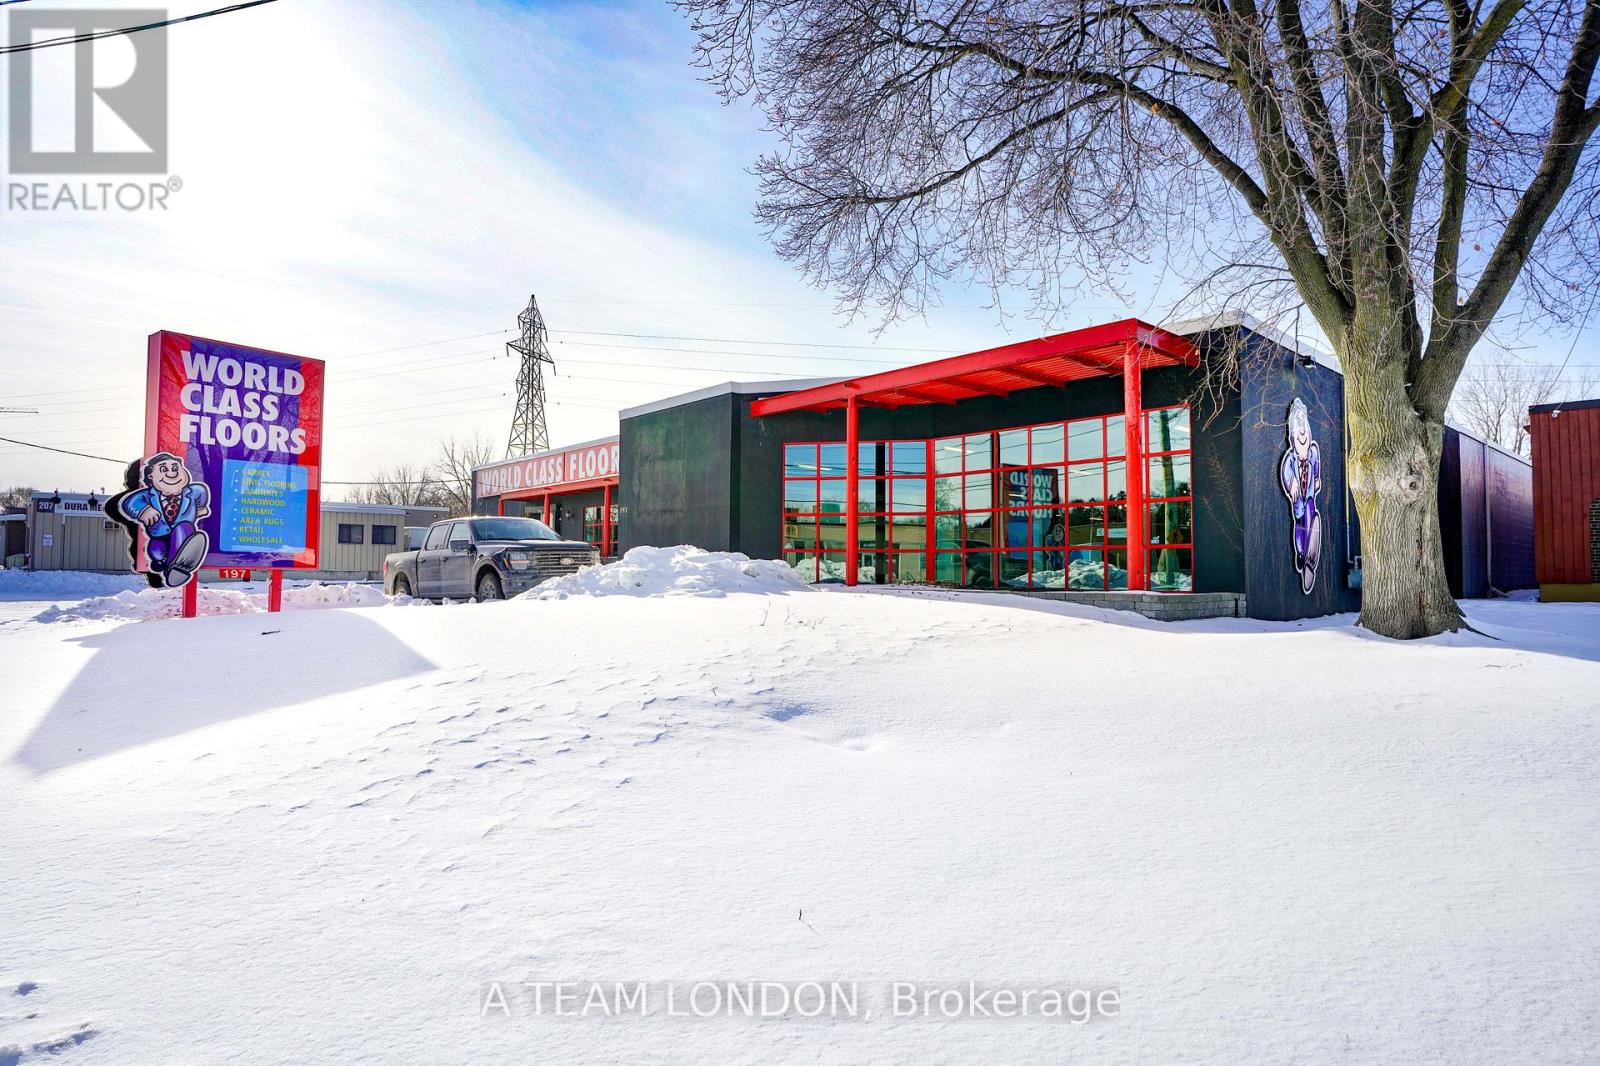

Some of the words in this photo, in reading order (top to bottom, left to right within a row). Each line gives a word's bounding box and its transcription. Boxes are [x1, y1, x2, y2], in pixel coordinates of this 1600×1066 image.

[181, 350, 305, 396] WORLD
[180, 382, 280, 422] CLASS
[179, 413, 306, 455] FLOORS
[481, 465, 521, 495] WORLD
[525, 456, 564, 487] CLASS
[241, 488, 284, 498] LAMINATES
[39, 501, 54, 510] 207
[64, 502, 88, 511] DURA
[241, 498, 286, 507] HARDWOOD
[240, 507, 275, 515] CERAMIC
[240, 517, 261, 525] AREA
[263, 518, 284, 526] RUGS
[239, 526, 265, 534] RETAIL
[239, 535, 285, 544] WHOLESALE
[223, 569, 247, 578] 197
